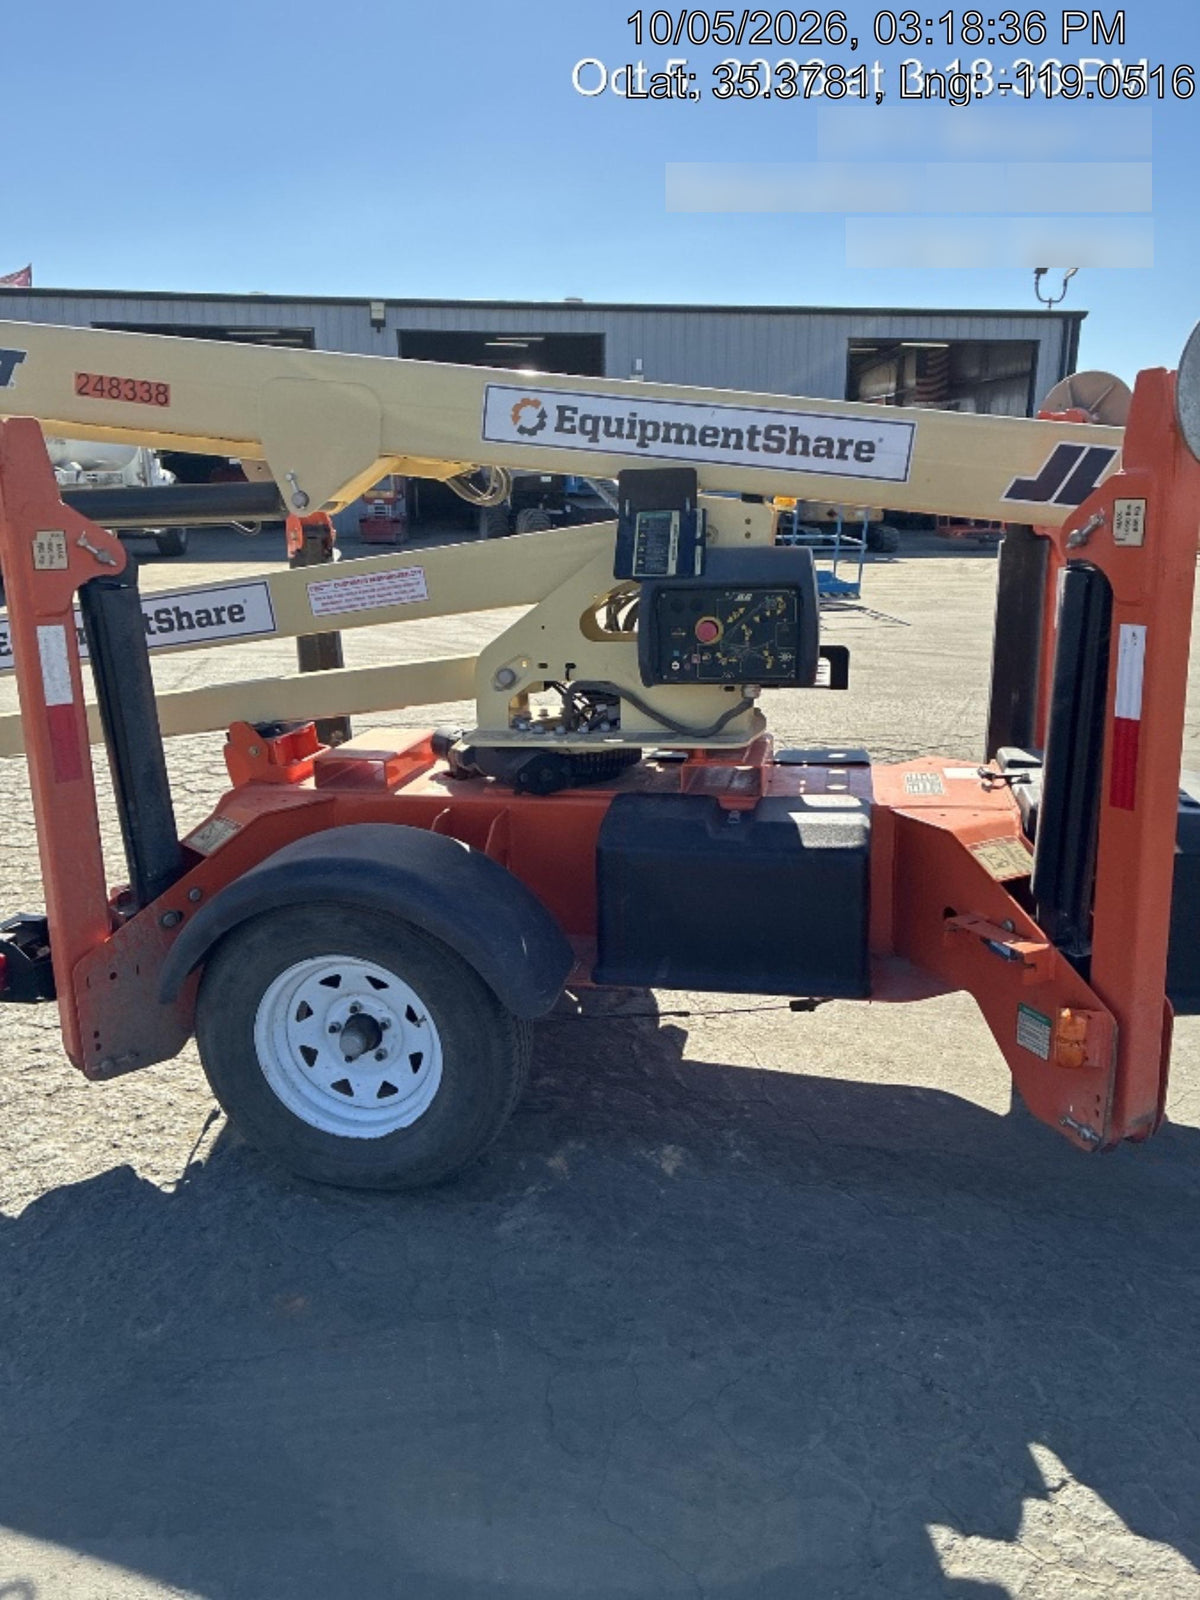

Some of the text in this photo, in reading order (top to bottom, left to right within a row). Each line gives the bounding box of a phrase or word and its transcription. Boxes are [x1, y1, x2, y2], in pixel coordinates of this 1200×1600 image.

[76, 372, 170, 406] 248338
[554, 404, 877, 464] EquipmentShare
[1001, 442, 1119, 505] JL
